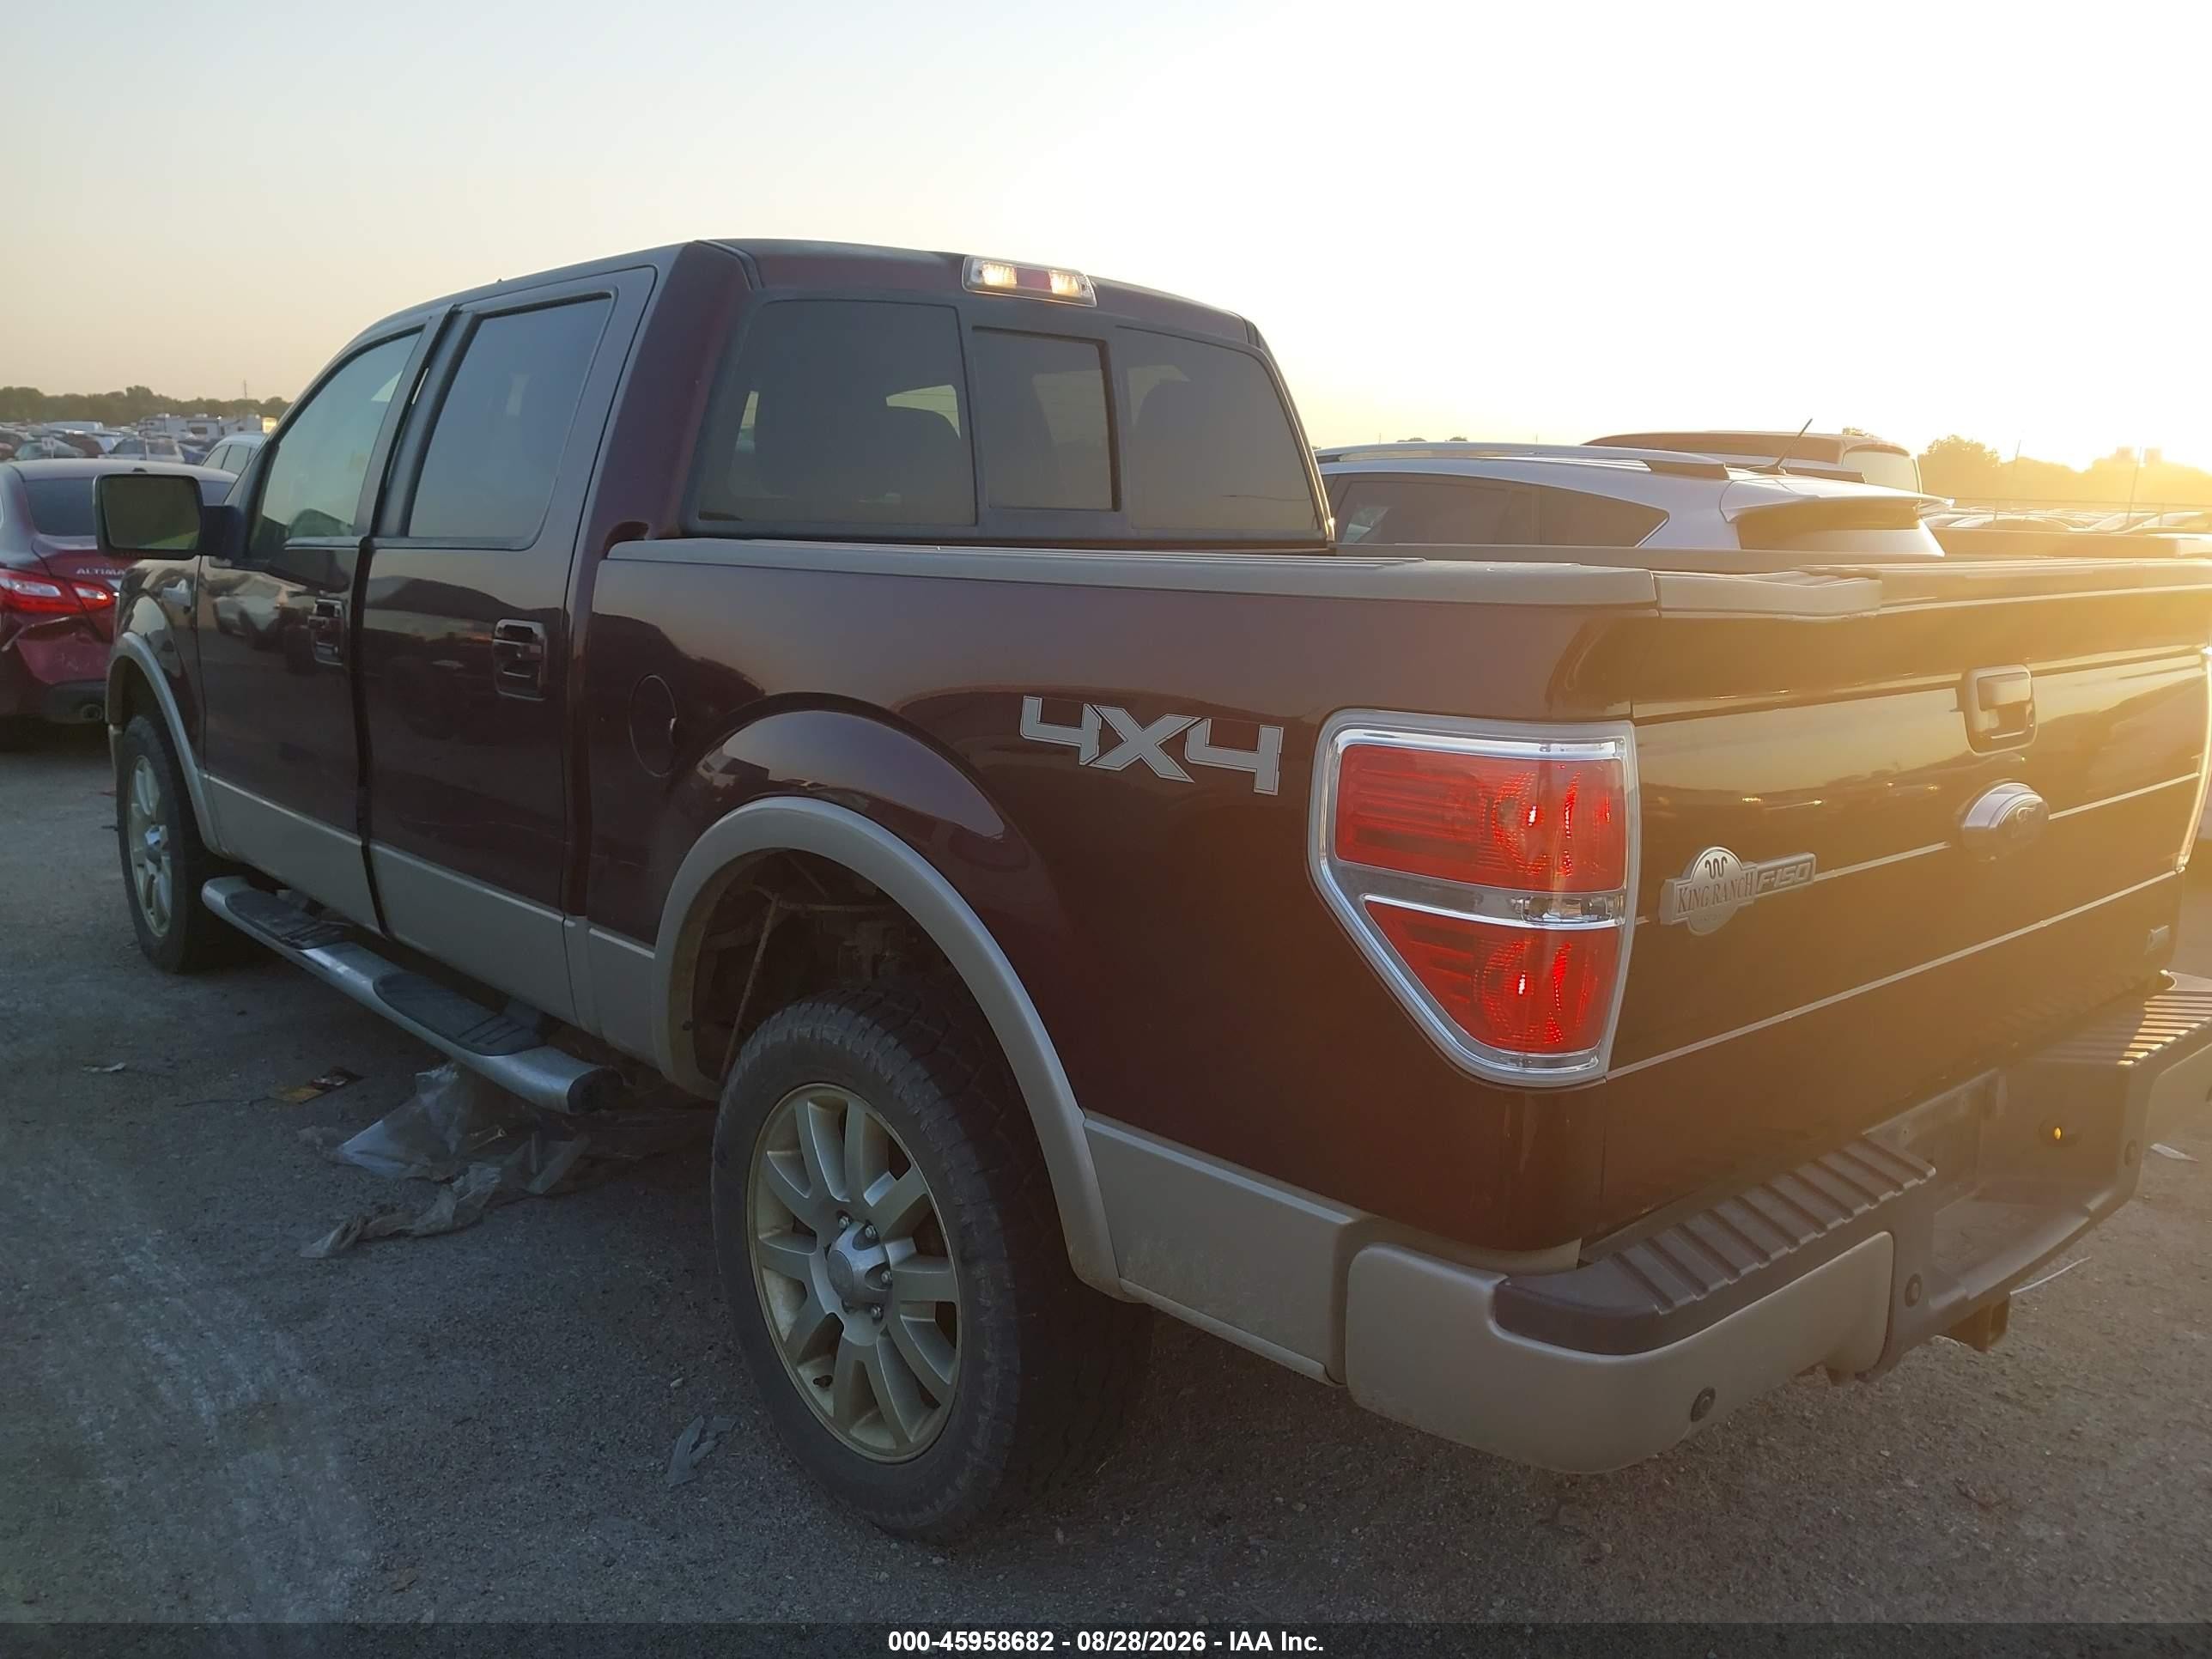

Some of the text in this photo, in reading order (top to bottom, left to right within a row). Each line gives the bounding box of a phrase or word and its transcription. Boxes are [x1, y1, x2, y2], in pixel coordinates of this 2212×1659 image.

[76, 568, 126, 576] ALTIMA
[1020, 696, 1284, 795] 4X4
[1677, 871, 1753, 914] KING RANCH
